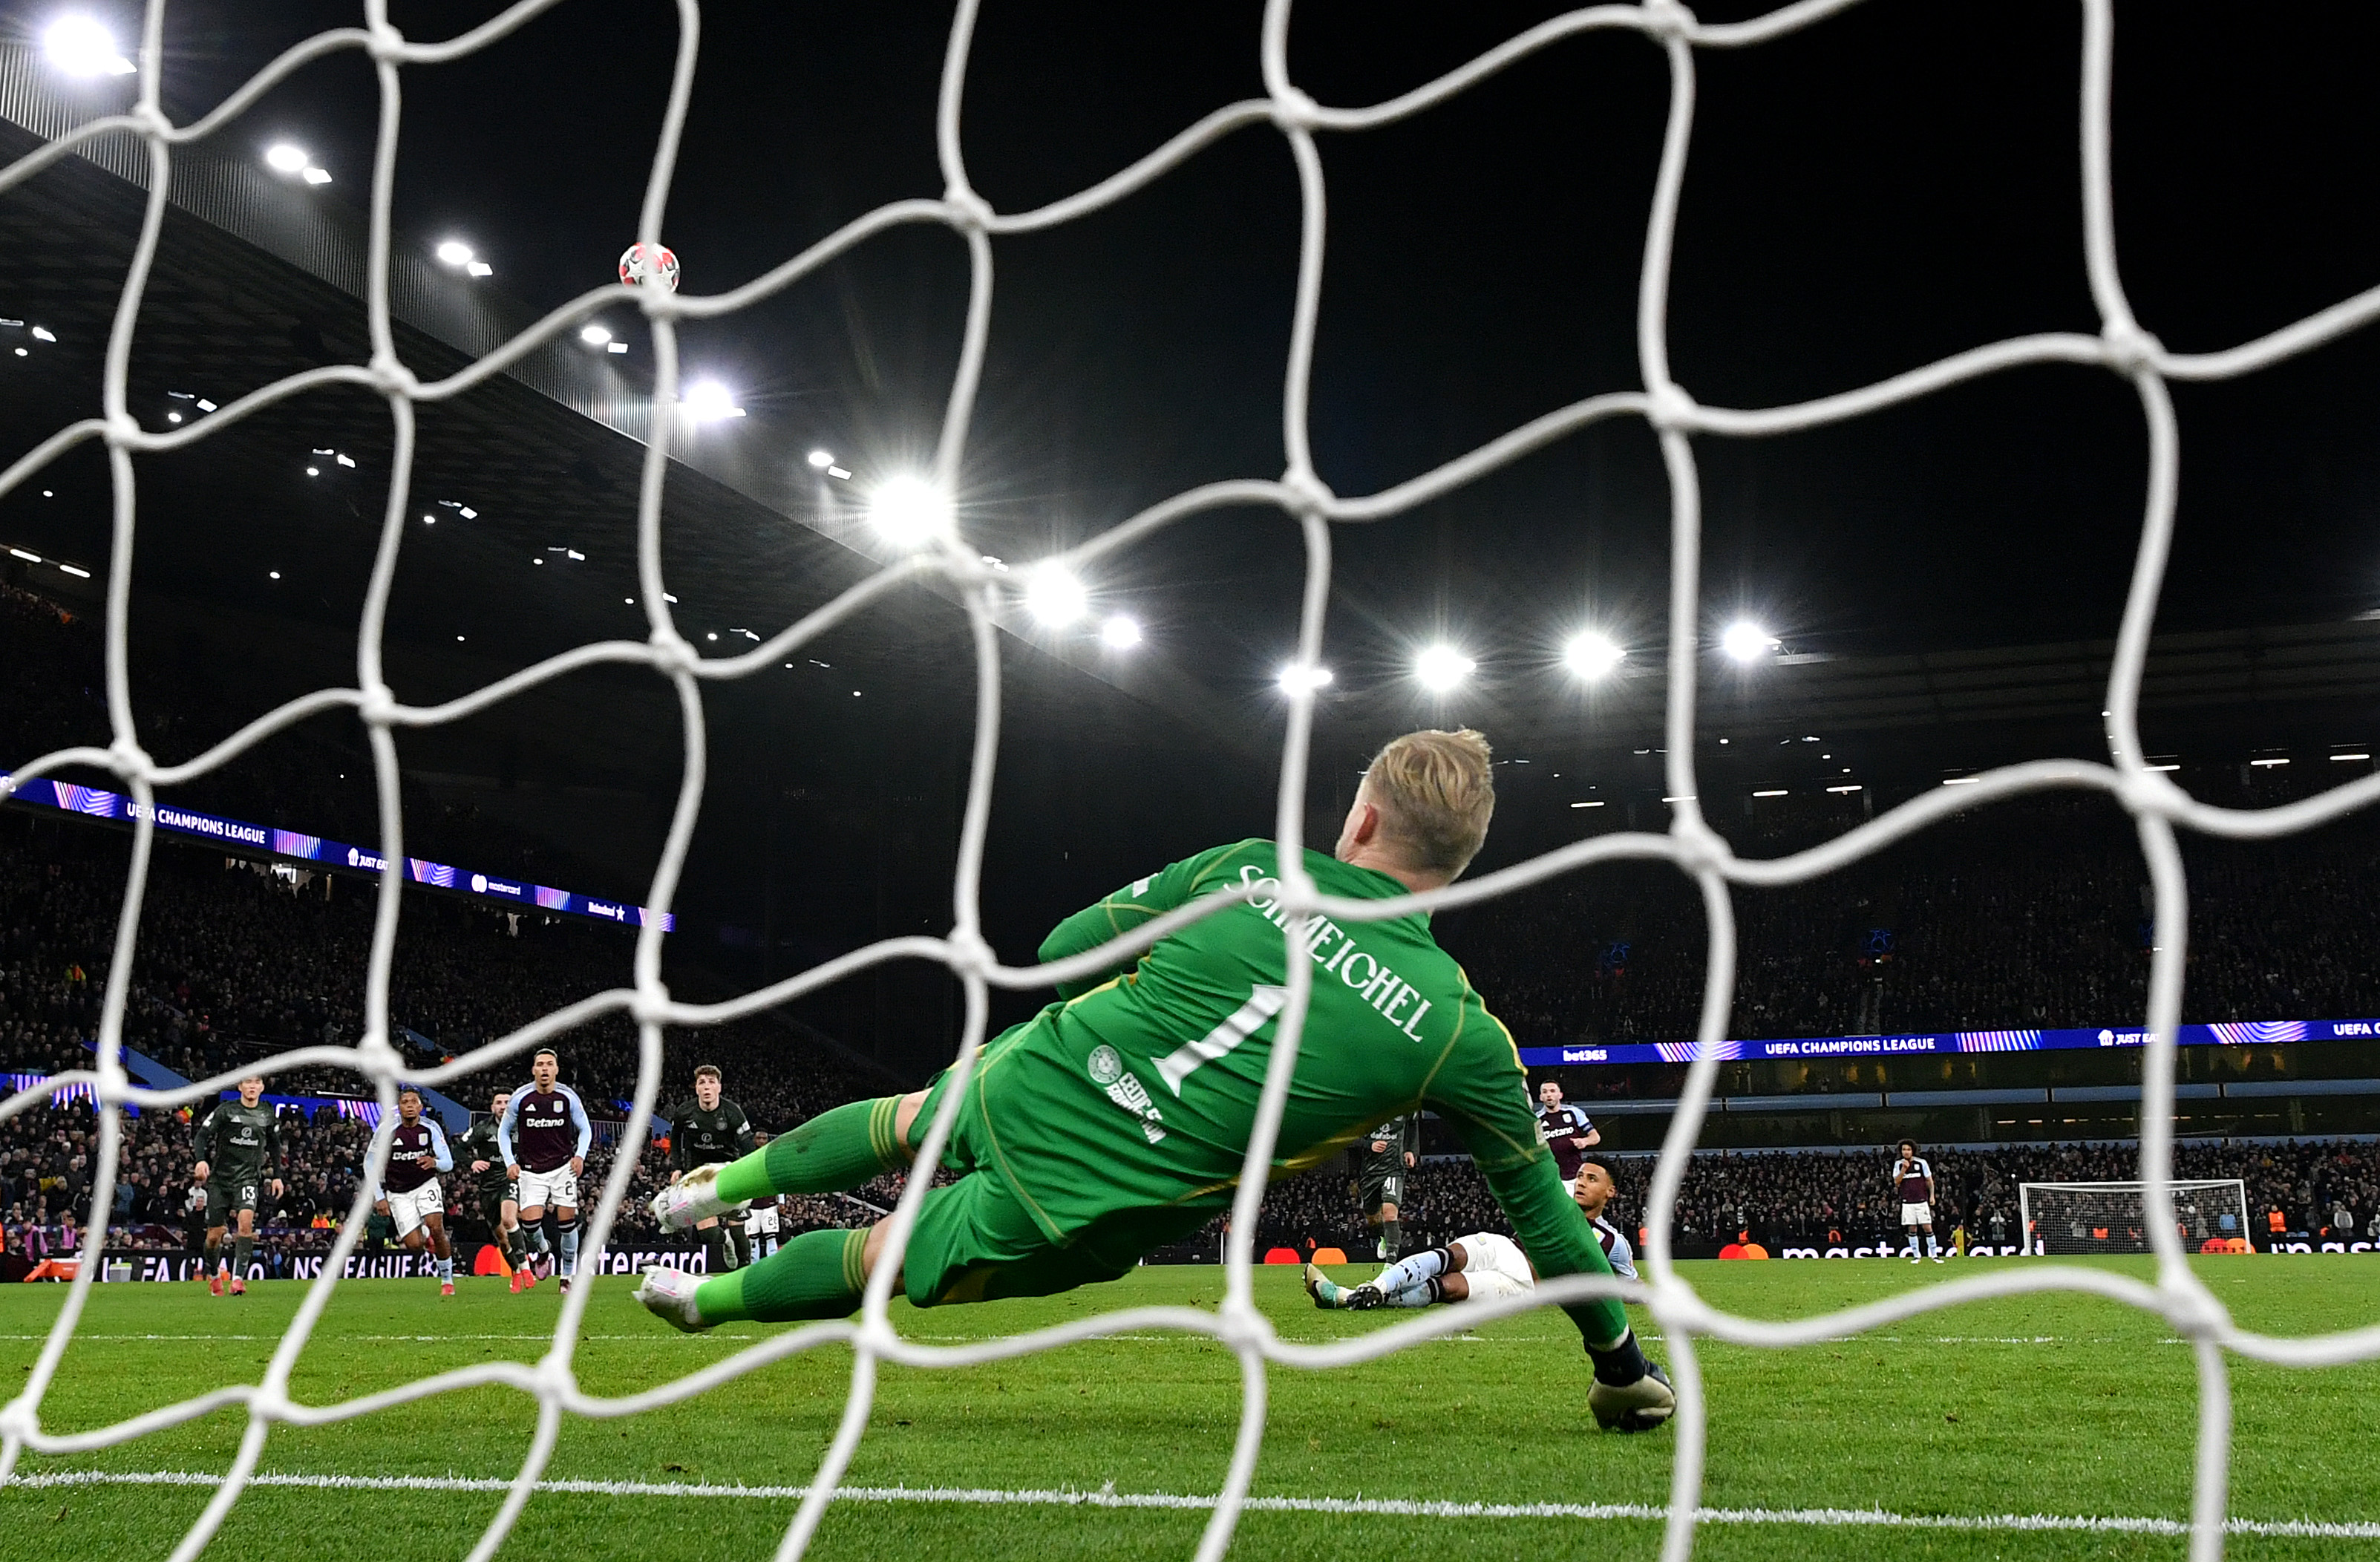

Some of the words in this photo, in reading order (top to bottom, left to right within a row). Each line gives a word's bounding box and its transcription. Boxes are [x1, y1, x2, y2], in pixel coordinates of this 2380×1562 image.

[127, 802, 156, 821] UEA
[158, 809, 223, 835] CHAMPIONS
[225, 823, 266, 844] LEAGUE
[359, 855, 376, 868] JUST
[2333, 1023, 2372, 1036] UEFA
[1150, 984, 1290, 1097] 1
[1765, 1042, 1799, 1055] UEFA
[1801, 1039, 1881, 1053] CHAMPIONS
[1883, 1037, 1935, 1050] LEAGUE
[2116, 1033, 2141, 1045] JUST
[1563, 1050, 1607, 1062] bet365
[526, 1118, 564, 1128] Betano
[1384, 1176, 1396, 1190] 41
[241, 1186, 255, 1200] 13
[528, 1244, 707, 1275] sterard
[343, 1255, 413, 1279] EAGUE
